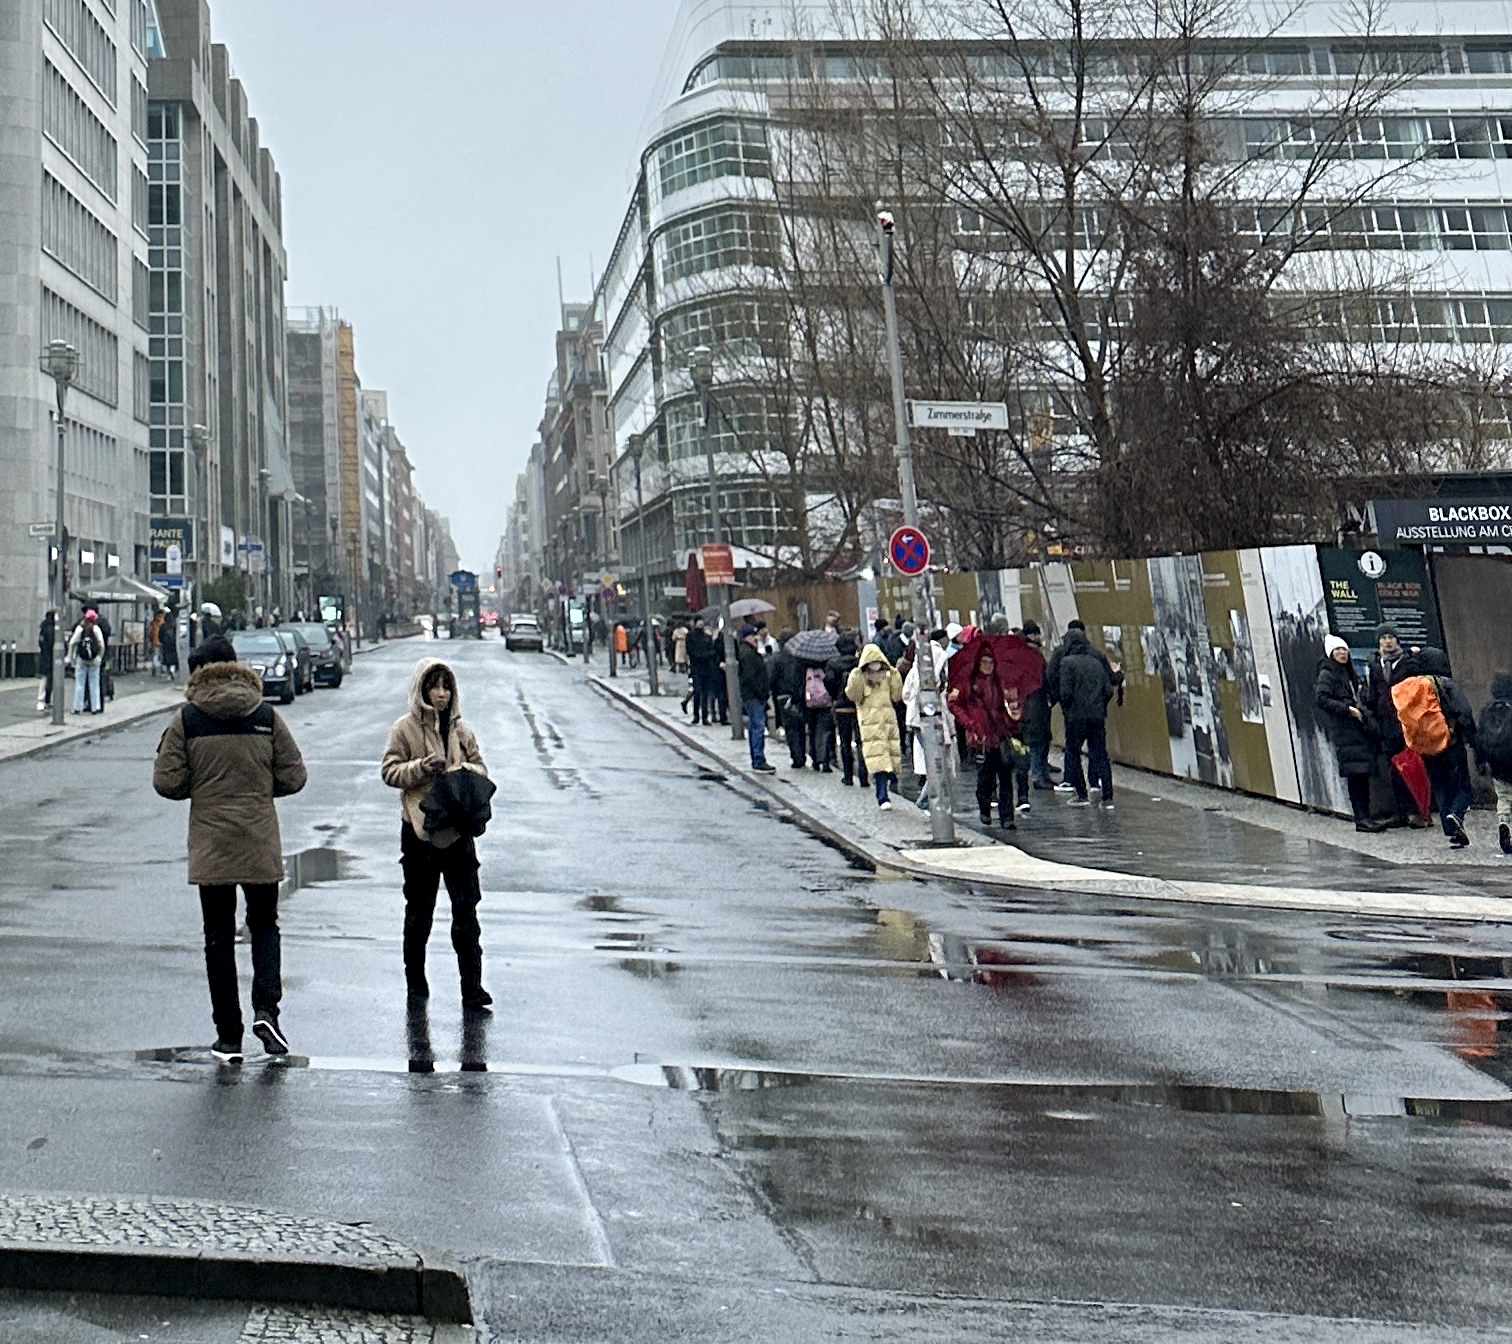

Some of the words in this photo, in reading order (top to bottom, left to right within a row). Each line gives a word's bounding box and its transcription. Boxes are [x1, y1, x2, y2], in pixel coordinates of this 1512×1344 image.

[927, 407, 993, 423] Zimmerstraße
[1428, 505, 1511, 522] BLACKBOX
[1396, 525, 1476, 539] AUSSTELLUNG
[1479, 525, 1499, 538] AM
[1329, 580, 1349, 590] THE
[1330, 589, 1359, 599] WALL
